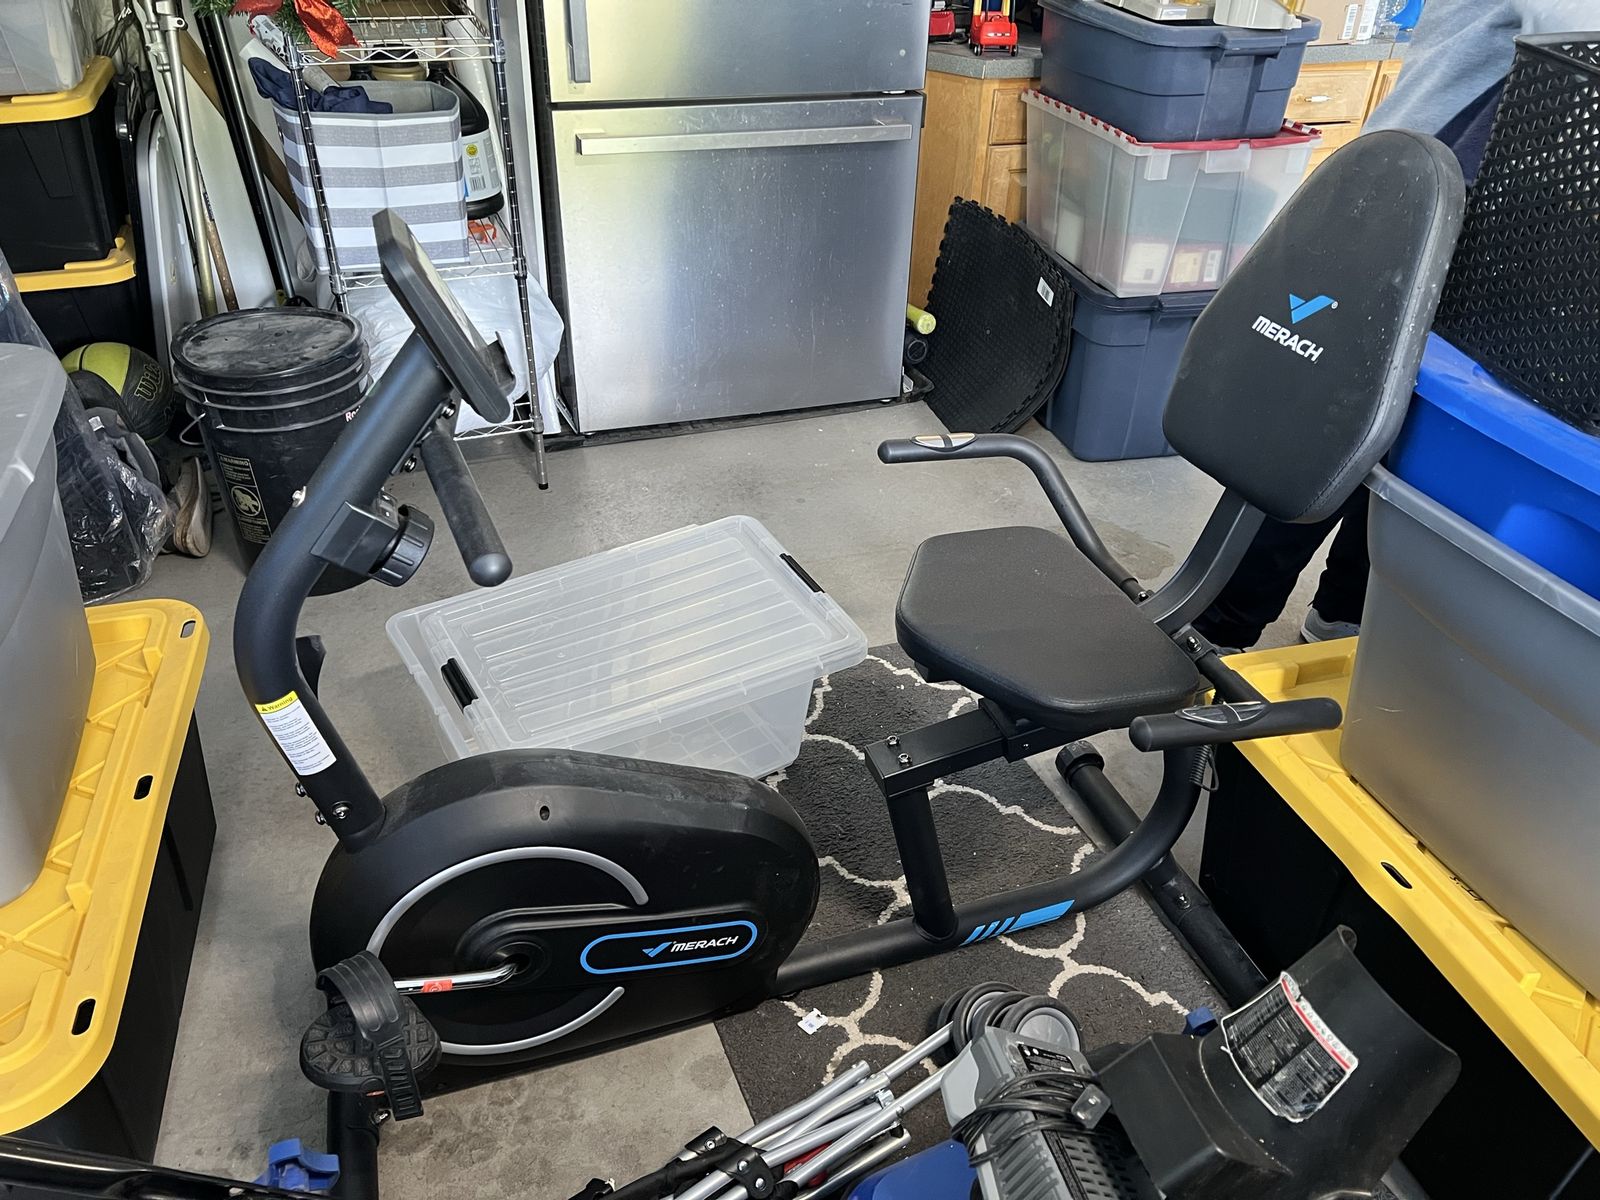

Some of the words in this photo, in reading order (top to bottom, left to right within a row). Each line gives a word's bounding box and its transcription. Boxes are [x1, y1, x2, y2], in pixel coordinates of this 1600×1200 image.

[1251, 315, 1324, 362] MERACH
[268, 696, 293, 711] Warning
[670, 935, 738, 952] MERACH
